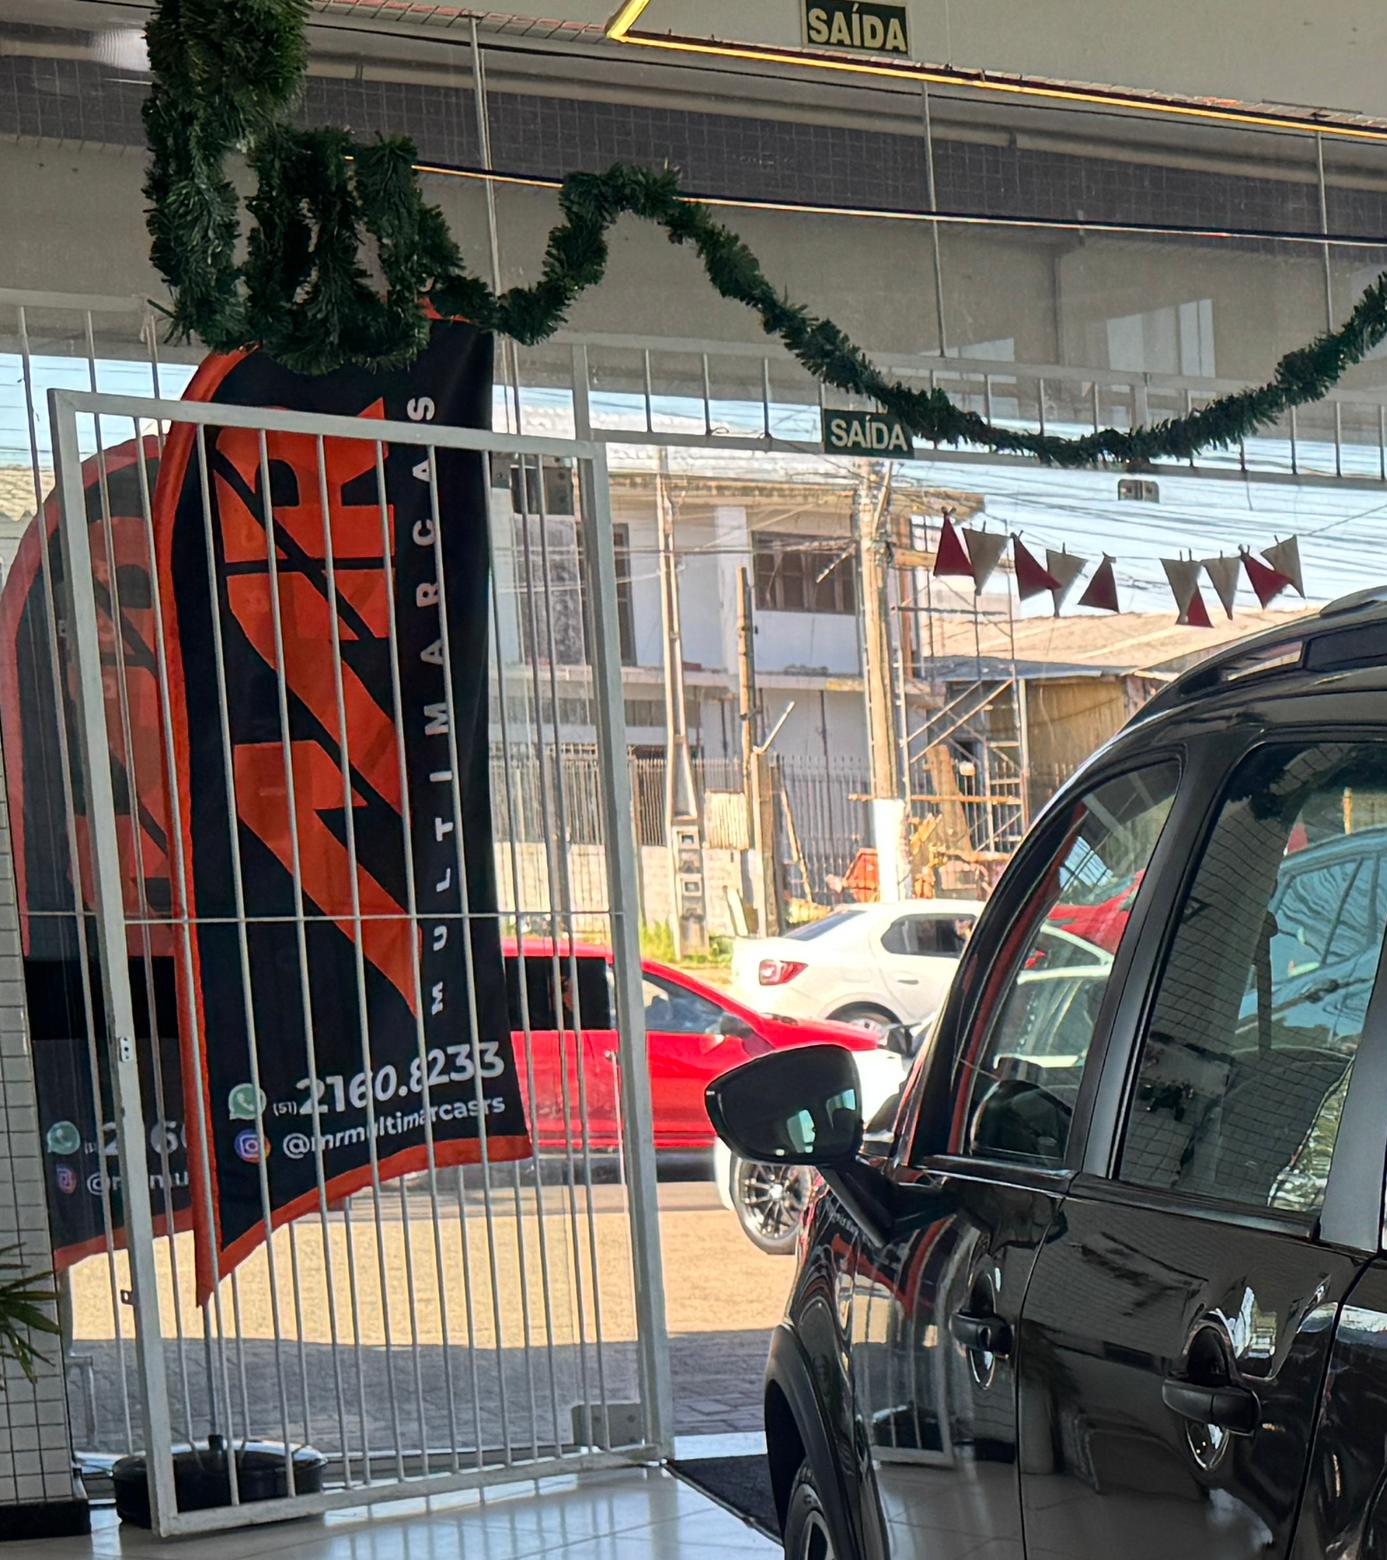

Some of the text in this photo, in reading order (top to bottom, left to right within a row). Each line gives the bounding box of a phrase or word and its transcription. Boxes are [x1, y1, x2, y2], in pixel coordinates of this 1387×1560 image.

[807, 3, 908, 52] SAÍDA
[830, 415, 909, 453] SAÍDA
[406, 396, 454, 1016] MULTIMARCAS
